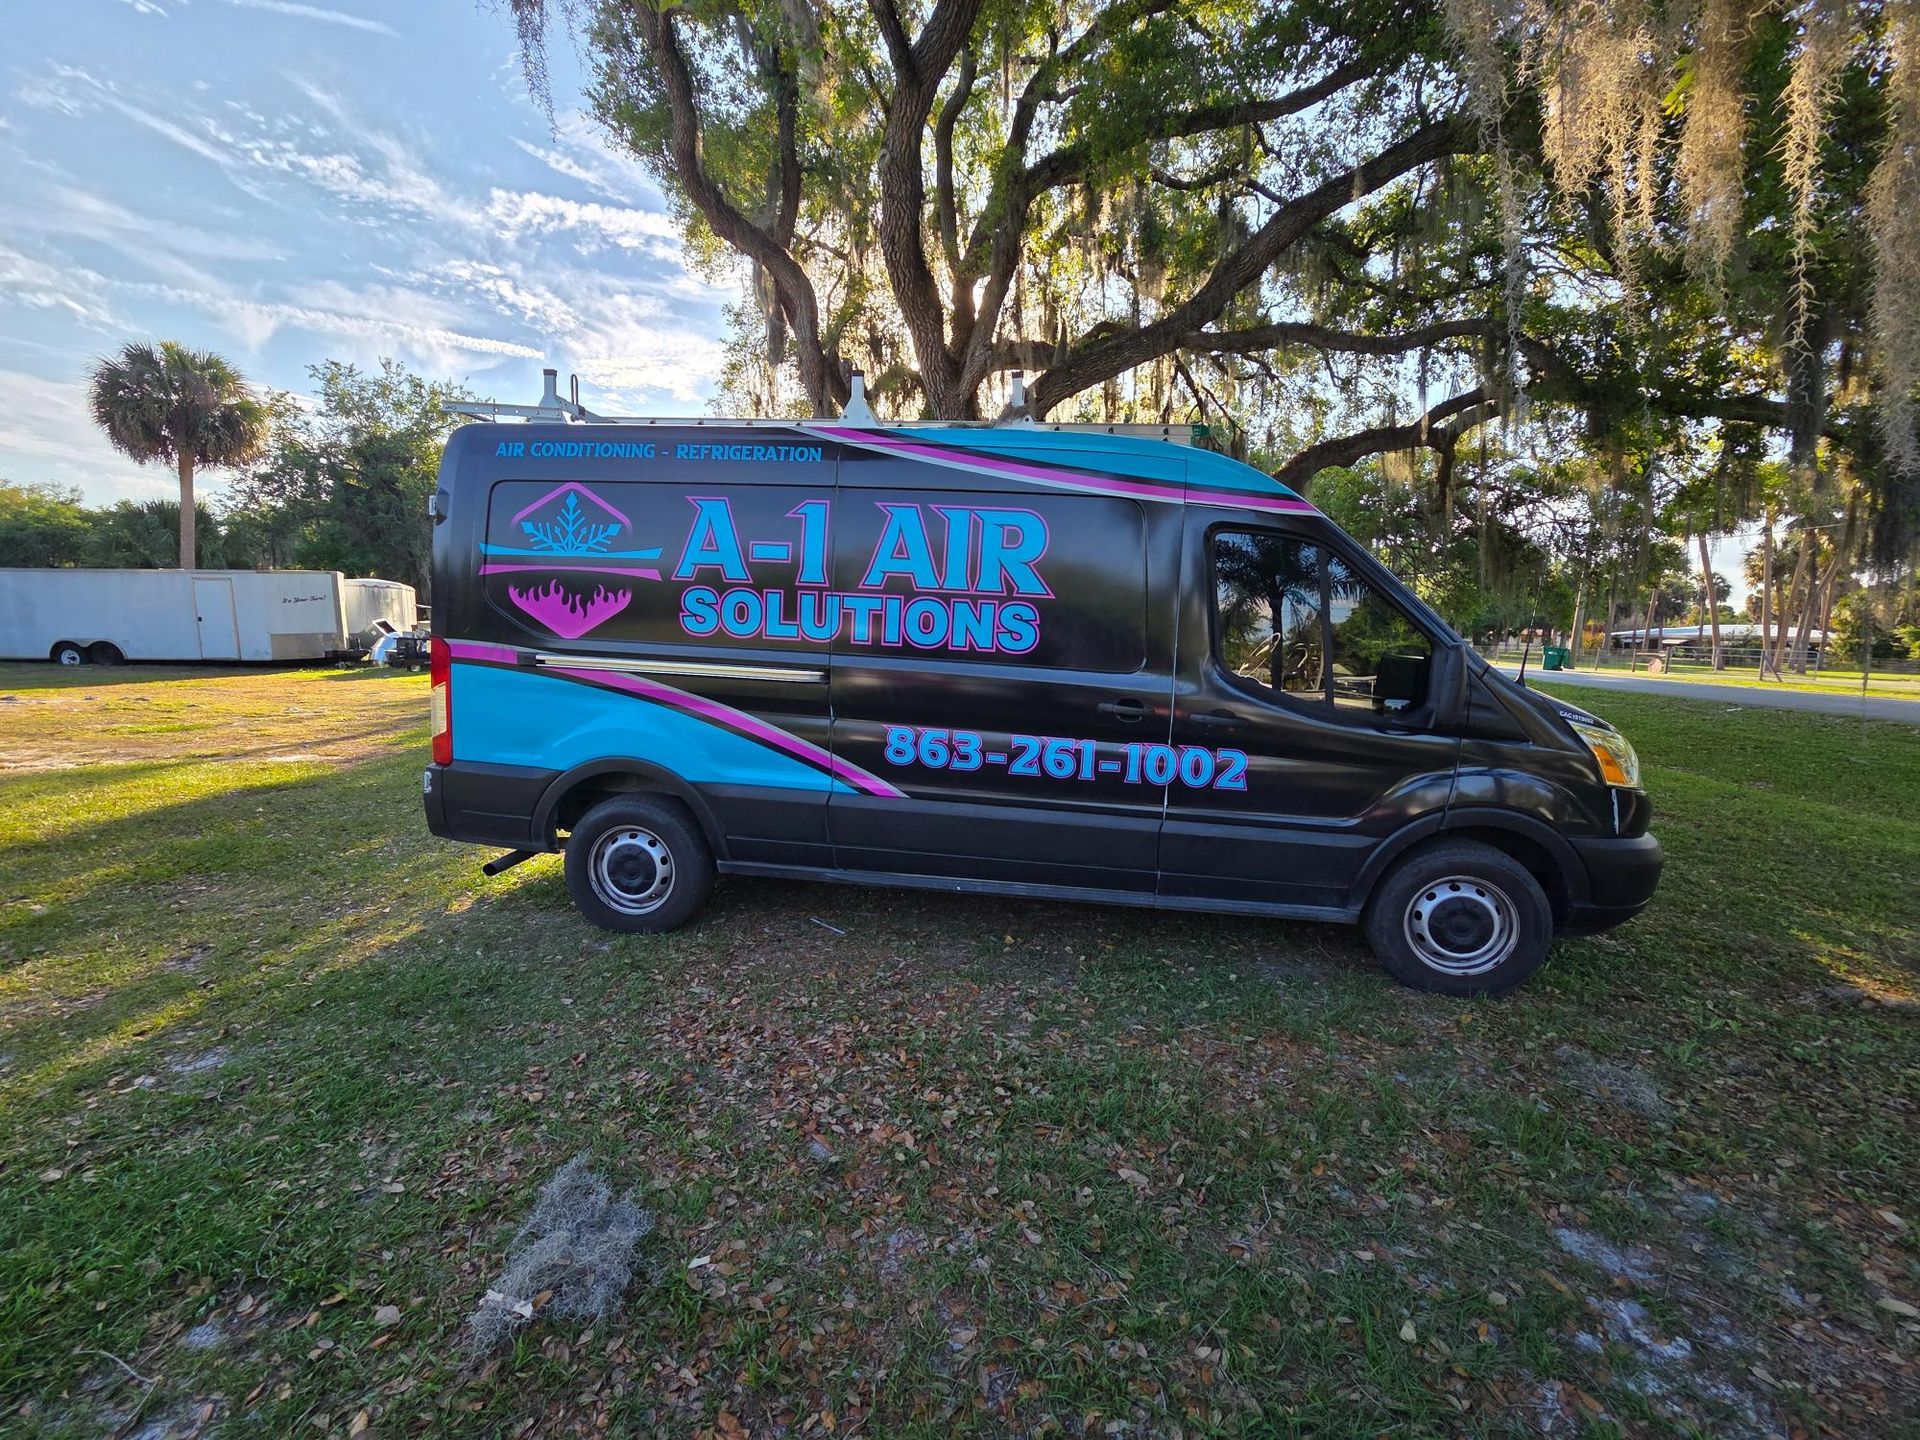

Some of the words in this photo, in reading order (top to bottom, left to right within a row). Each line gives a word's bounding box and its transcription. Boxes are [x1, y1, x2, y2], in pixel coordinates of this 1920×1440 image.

[495, 441, 525, 457] AIR
[530, 441, 656, 459] CONDITIONING
[676, 443, 823, 463] REFRIGERATION
[671, 496, 831, 587] A-1
[858, 502, 1056, 598] AIR
[679, 586, 1041, 655] SOLUTIONS
[881, 724, 1248, 791] 863-261-1002
